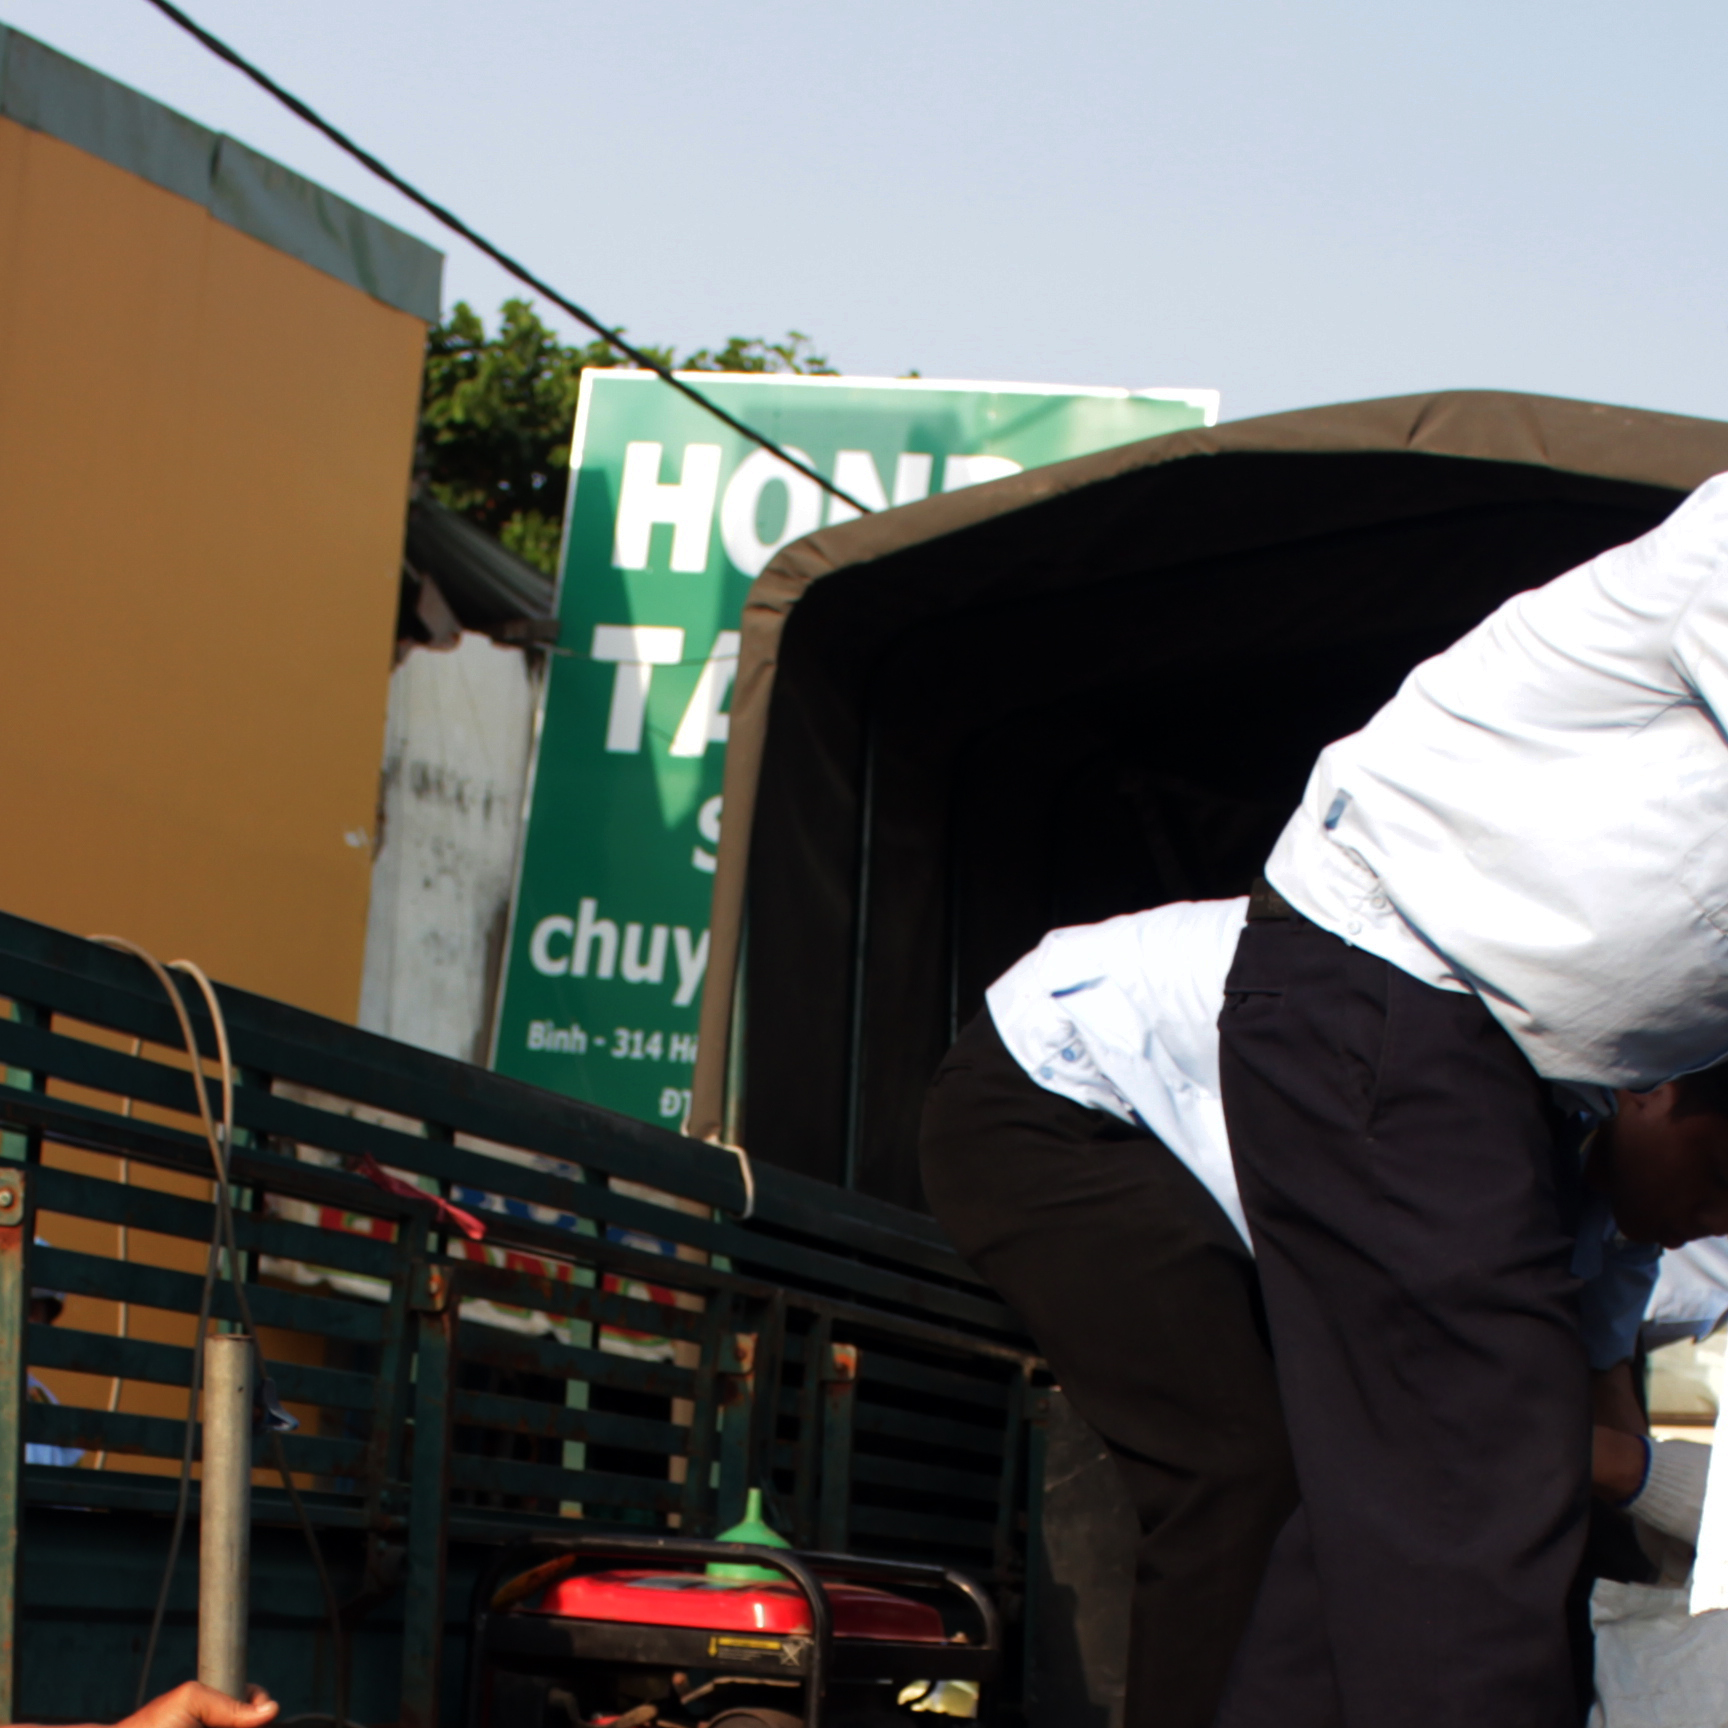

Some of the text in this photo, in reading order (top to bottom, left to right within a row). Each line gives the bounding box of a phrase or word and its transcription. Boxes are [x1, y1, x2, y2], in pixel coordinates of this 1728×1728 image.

[610, 440, 1025, 580] HON
[528, 898, 711, 1007] chuy
[610, 1026, 663, 1061] 314
